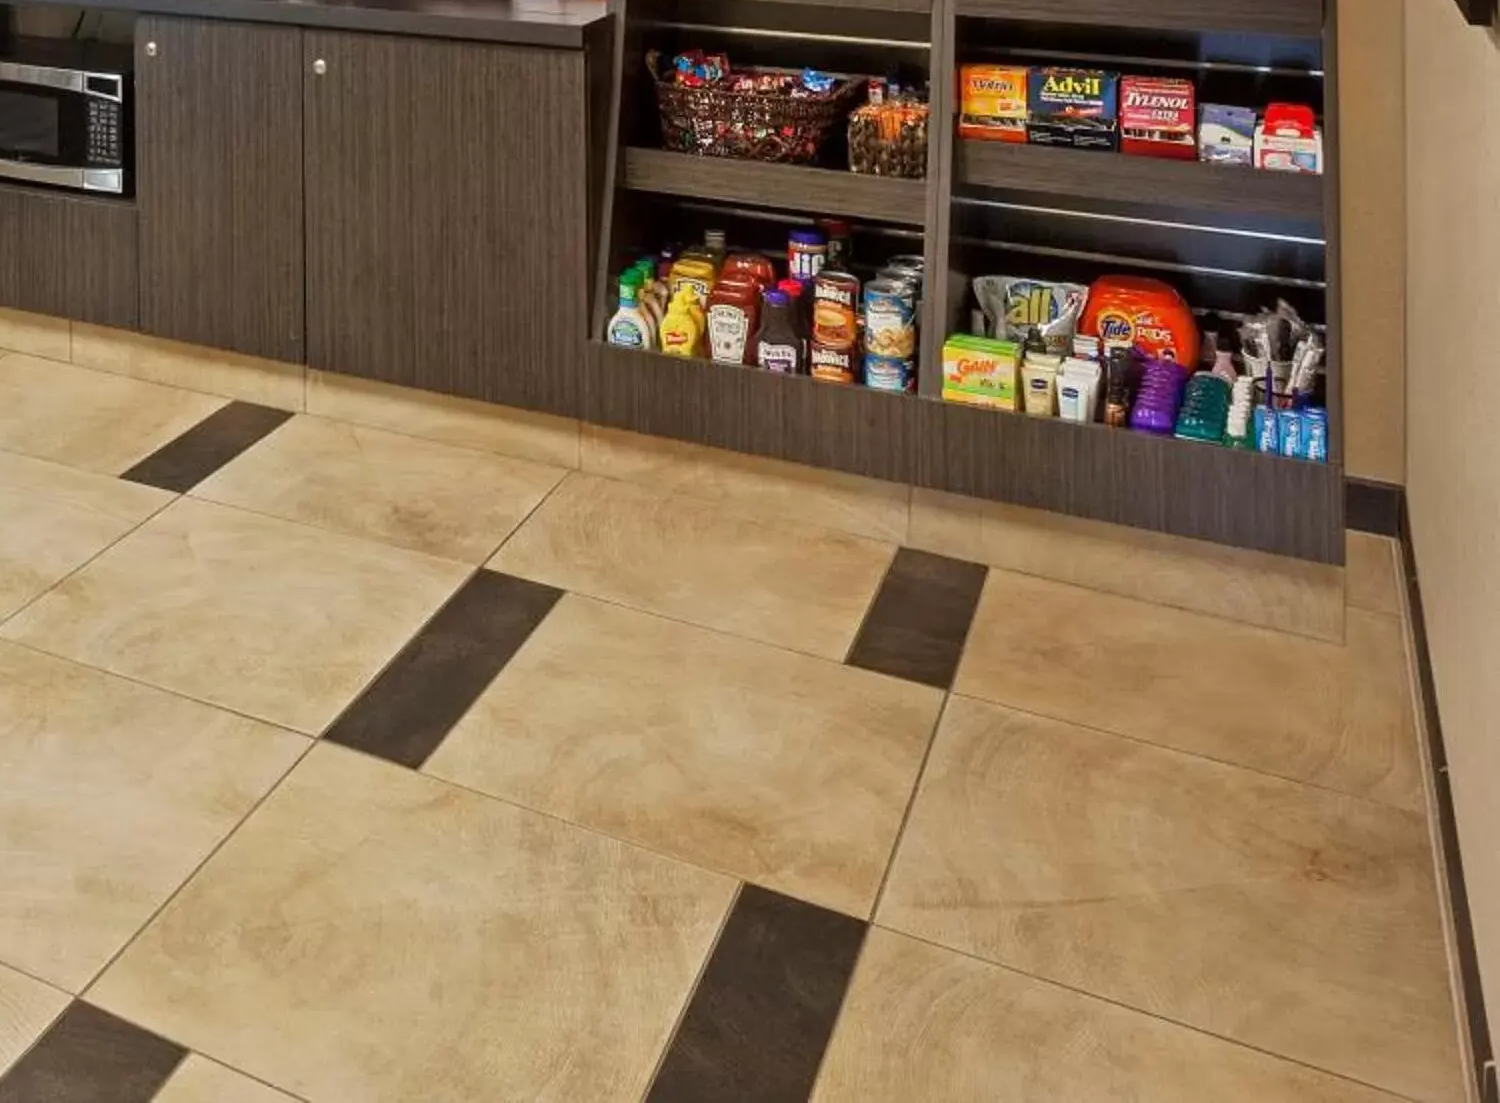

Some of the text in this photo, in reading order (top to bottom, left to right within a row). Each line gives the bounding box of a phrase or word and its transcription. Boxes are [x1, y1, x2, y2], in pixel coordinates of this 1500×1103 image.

[1043, 76, 1101, 95] Advil
[1127, 92, 1189, 110] TYLENOL
[1008, 288, 1051, 325] all
[1102, 319, 1130, 337] Tide
